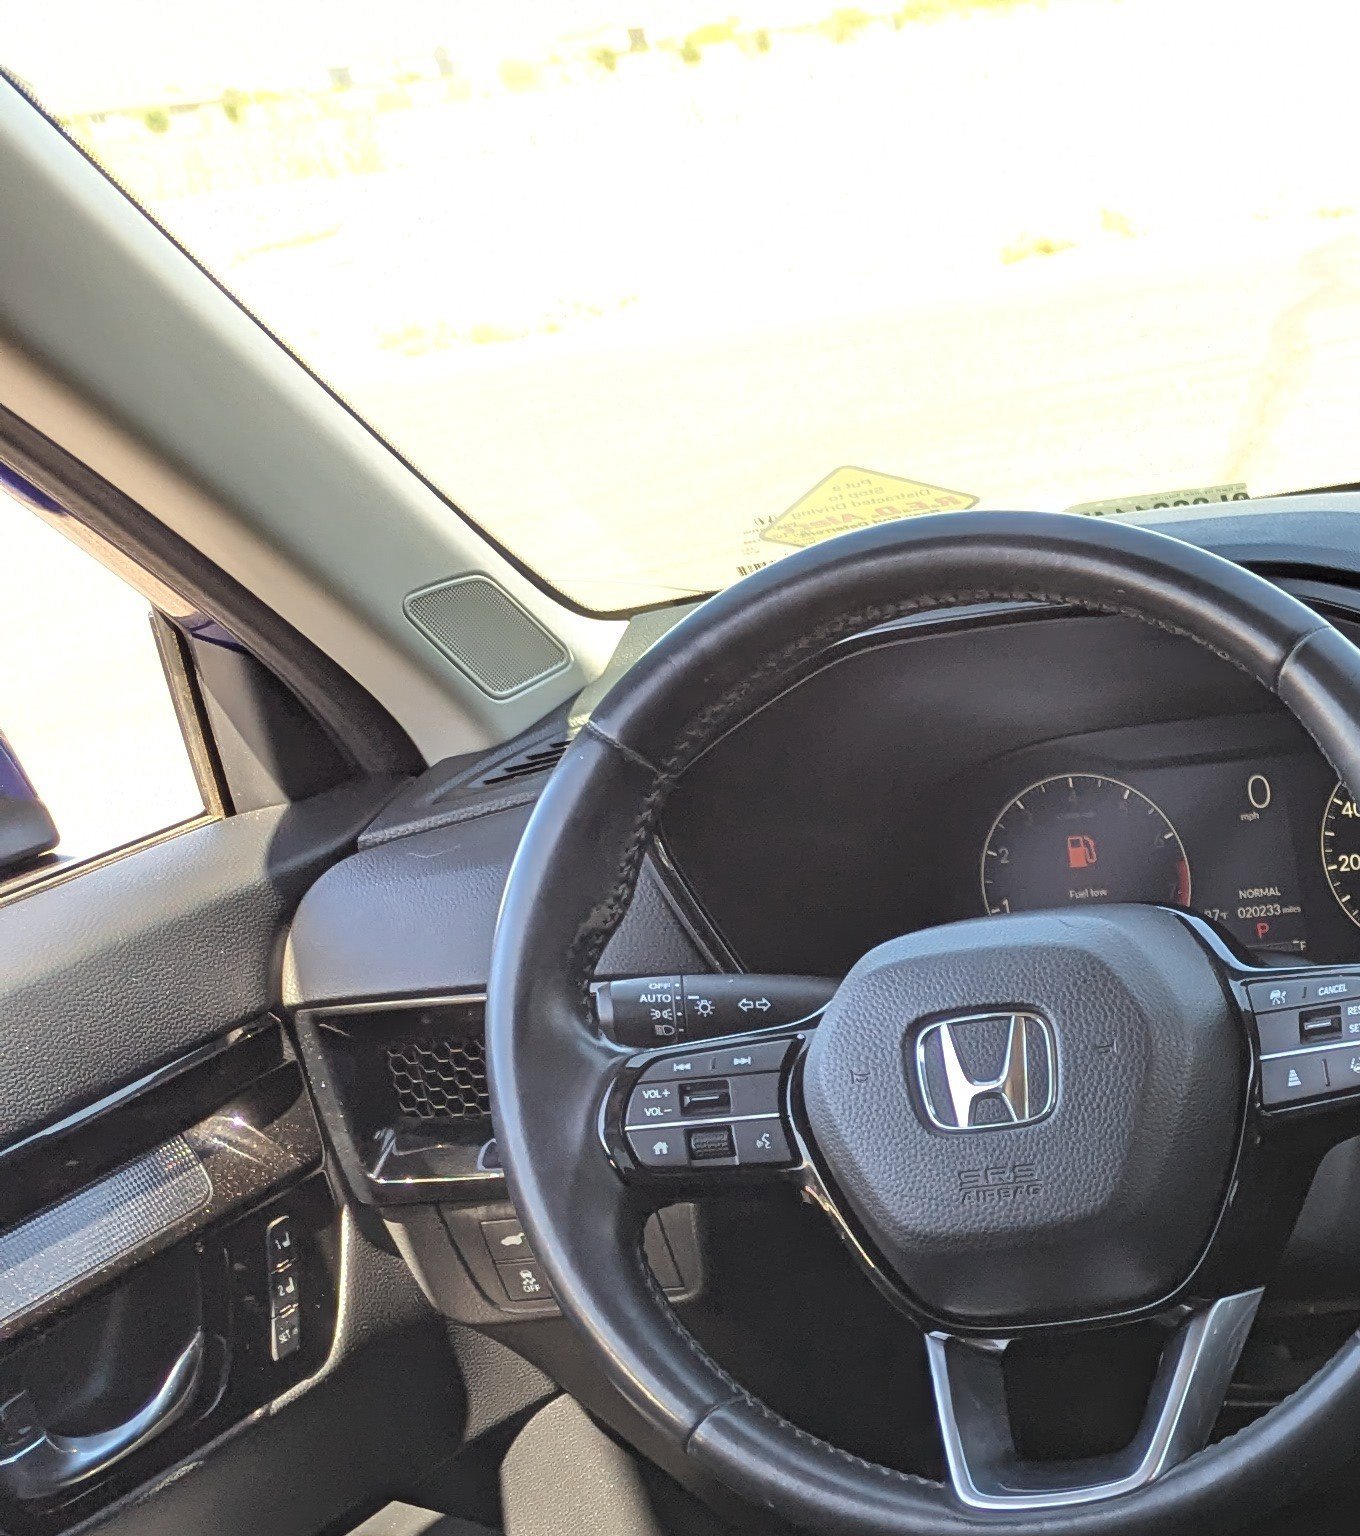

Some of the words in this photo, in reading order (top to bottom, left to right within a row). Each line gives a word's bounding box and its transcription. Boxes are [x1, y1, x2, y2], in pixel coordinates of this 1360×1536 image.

[1248, 775, 1271, 809] 0
[999, 848, 1009, 864] 2
[1239, 886, 1281, 899] NORMAL
[1238, 904, 1281, 919] 020233
[1318, 983, 1348, 996] CANCEL
[640, 994, 671, 1003] AUTO
